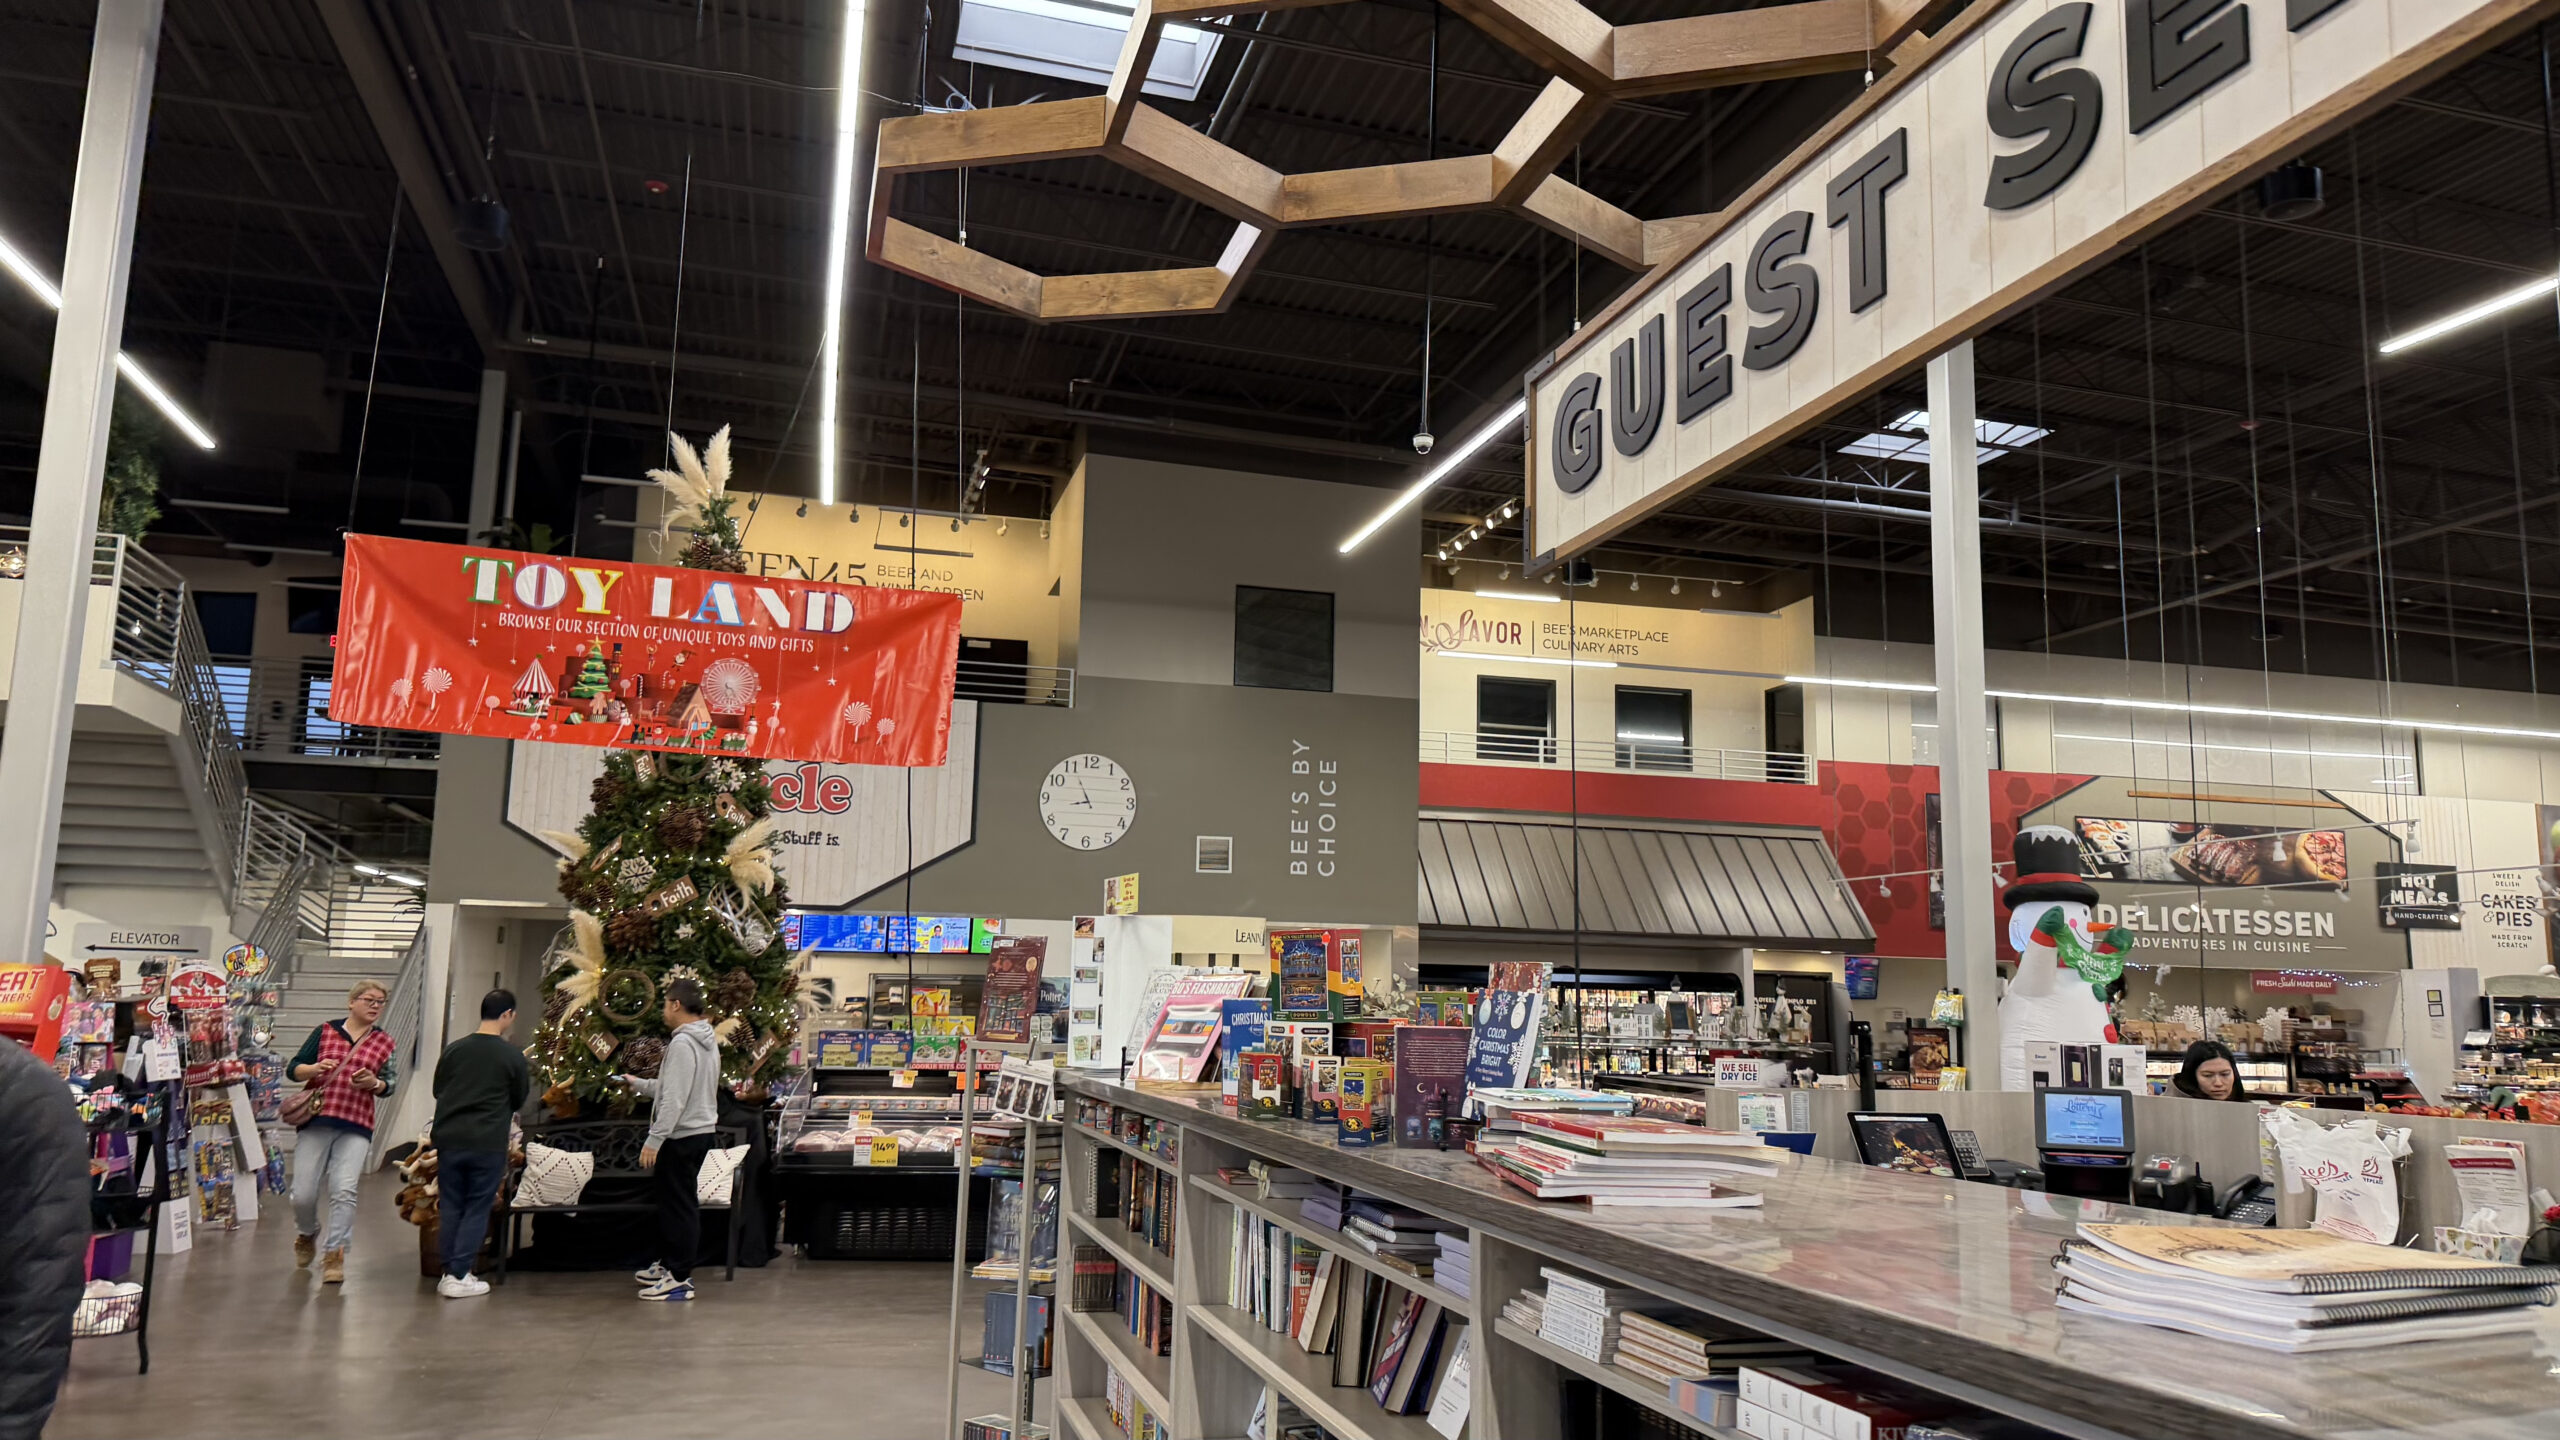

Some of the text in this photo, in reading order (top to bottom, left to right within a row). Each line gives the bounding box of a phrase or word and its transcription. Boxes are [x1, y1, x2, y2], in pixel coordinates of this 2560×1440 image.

[1552, 0, 2352, 495] GUEST SE
[742, 551, 867, 587] EN45
[877, 564, 954, 582] BEER AND
[462, 556, 856, 634] TOY LAND
[499, 612, 814, 653] BROWSE OUR SECTION OF UNIQUE TOYS AND GIFTS
[1543, 623, 1669, 643] BEE'S MARKETPLACE
[1542, 639, 1640, 656] CULINARY ARTS
[1064, 760, 1078, 773] 11
[1083, 755, 1100, 769] 12
[1108, 763, 1114, 776] 1
[1049, 774, 1065, 787] 10
[1120, 778, 1130, 791] 2
[760, 762, 854, 815] cle
[1041, 792, 1050, 805] 9
[1126, 797, 1135, 810] 3
[1290, 739, 1310, 875] BEE'S BY
[725, 804, 746, 828] Faith
[1046, 813, 1056, 826] 8
[1117, 816, 1127, 830] 4
[1317, 760, 1337, 877] CHOICE
[783, 830, 823, 846] Stuff
[1059, 828, 1069, 840] 7
[1081, 835, 1090, 848] 6
[1103, 832, 1112, 844] 5
[2400, 873, 2437, 889] HOT
[660, 881, 695, 908] Faith
[2390, 890, 2449, 907] MEALS
[2481, 893, 2537, 910] CAKES
[2097, 904, 2335, 938] DELICATESSEN
[2482, 911, 2533, 927] & PIES
[109, 931, 180, 946] ELEVATOR
[2131, 936, 2311, 953] ADVENTURES IN CUISINE
[2497, 941, 2528, 949] SCRATCH
[1192, 981, 1243, 995] FLASHBACK
[1231, 1011, 1268, 1026] CHRISTMAS
[1487, 1026, 1507, 1039] COLOR
[751, 1037, 776, 1061] Love
[1479, 1040, 1511, 1055] CHRISTMAS
[1481, 1054, 1502, 1067] BRIGHT
[1722, 1063, 1758, 1072] WE SELL
[1721, 1072, 1758, 1081] DRY ICE
